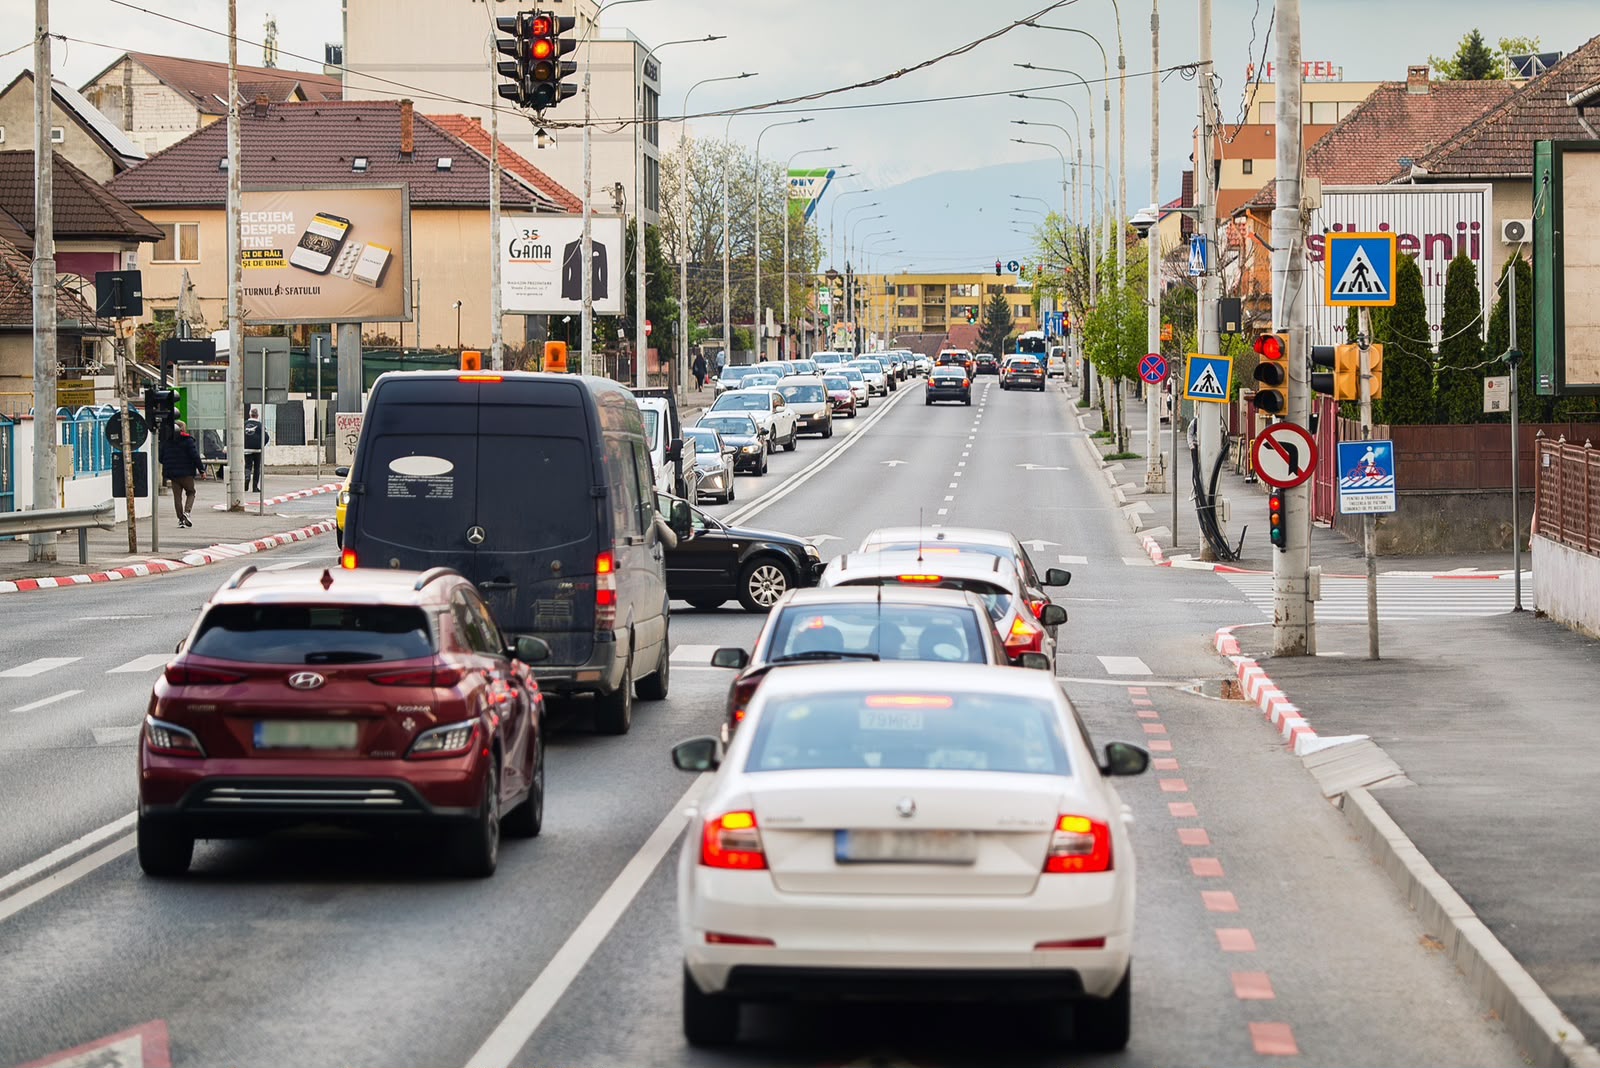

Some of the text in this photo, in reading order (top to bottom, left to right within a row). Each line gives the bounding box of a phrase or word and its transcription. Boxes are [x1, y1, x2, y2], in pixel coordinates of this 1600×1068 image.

[1267, 61, 1336, 77] HTEL
[240, 211, 293, 223] SCRIEM
[241, 223, 296, 235] DESPRE
[522, 229, 539, 240] 35
[242, 236, 274, 247] TINE
[252, 250, 263, 258] DE
[243, 286, 321, 296] TURNUL SFATULUI
